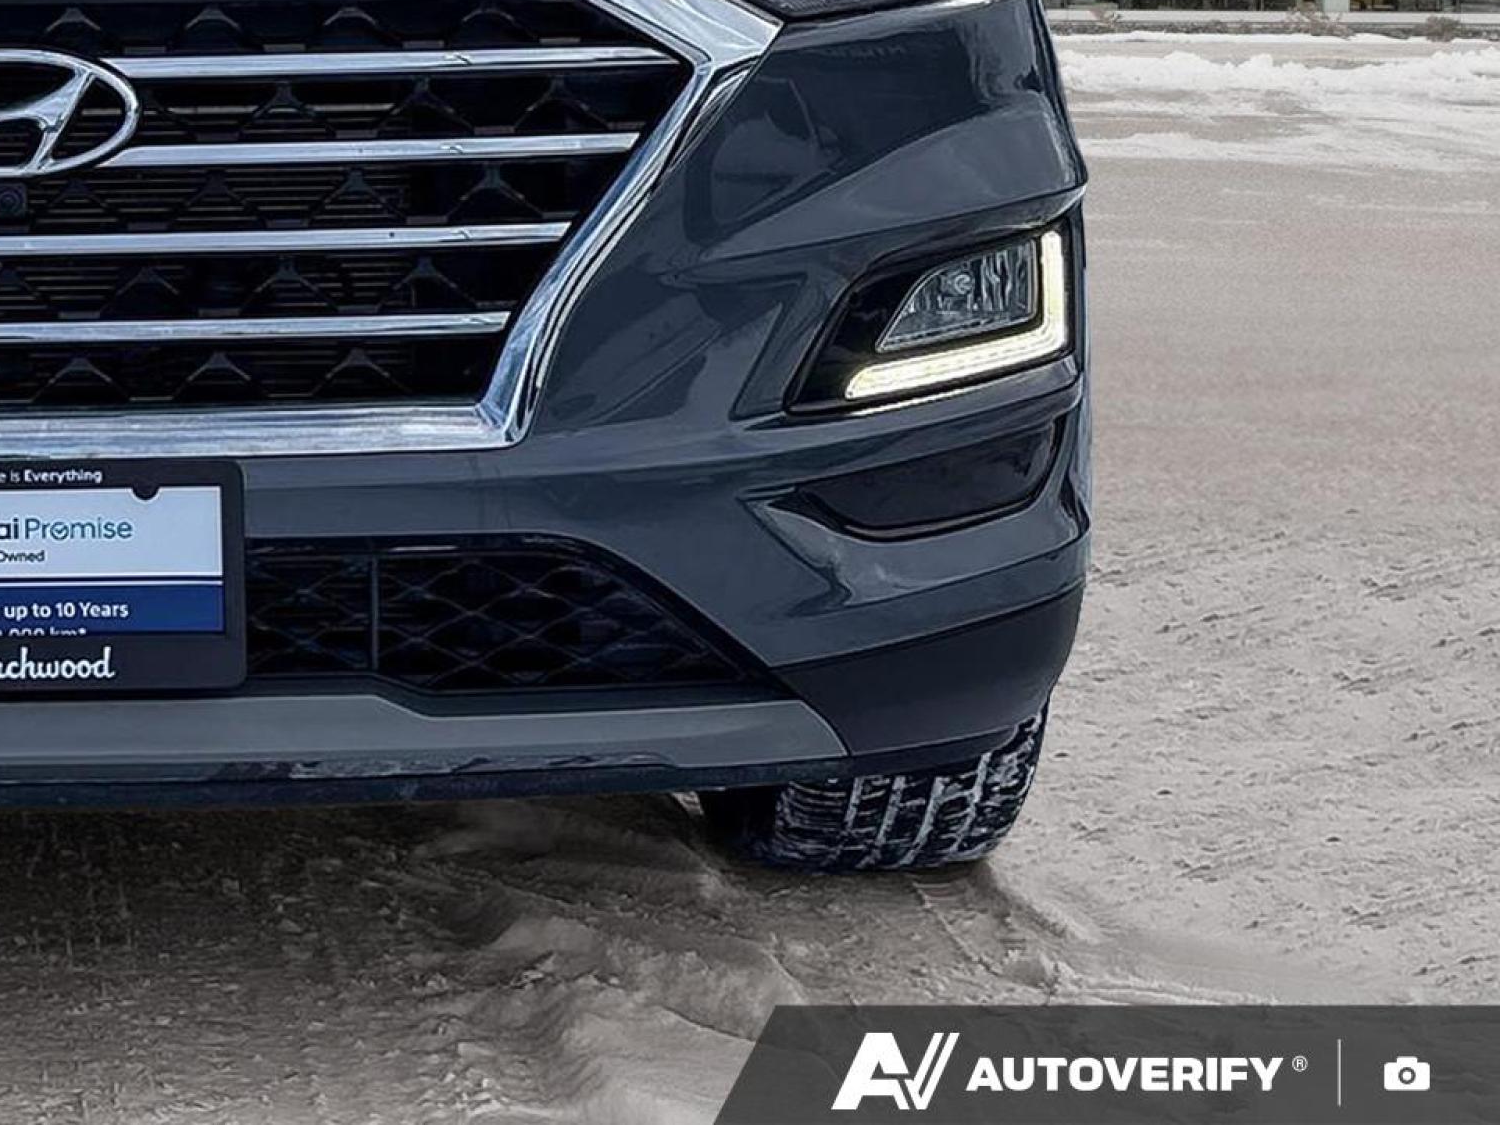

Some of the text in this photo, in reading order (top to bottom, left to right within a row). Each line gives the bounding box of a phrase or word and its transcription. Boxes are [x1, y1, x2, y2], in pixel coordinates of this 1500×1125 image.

[10, 470, 20, 482] is
[24, 469, 103, 484] Everything
[24, 517, 133, 540] Promise
[4, 606, 28, 621] up
[32, 603, 51, 618] to
[55, 602, 76, 618] 10
[78, 602, 129, 618] Years
